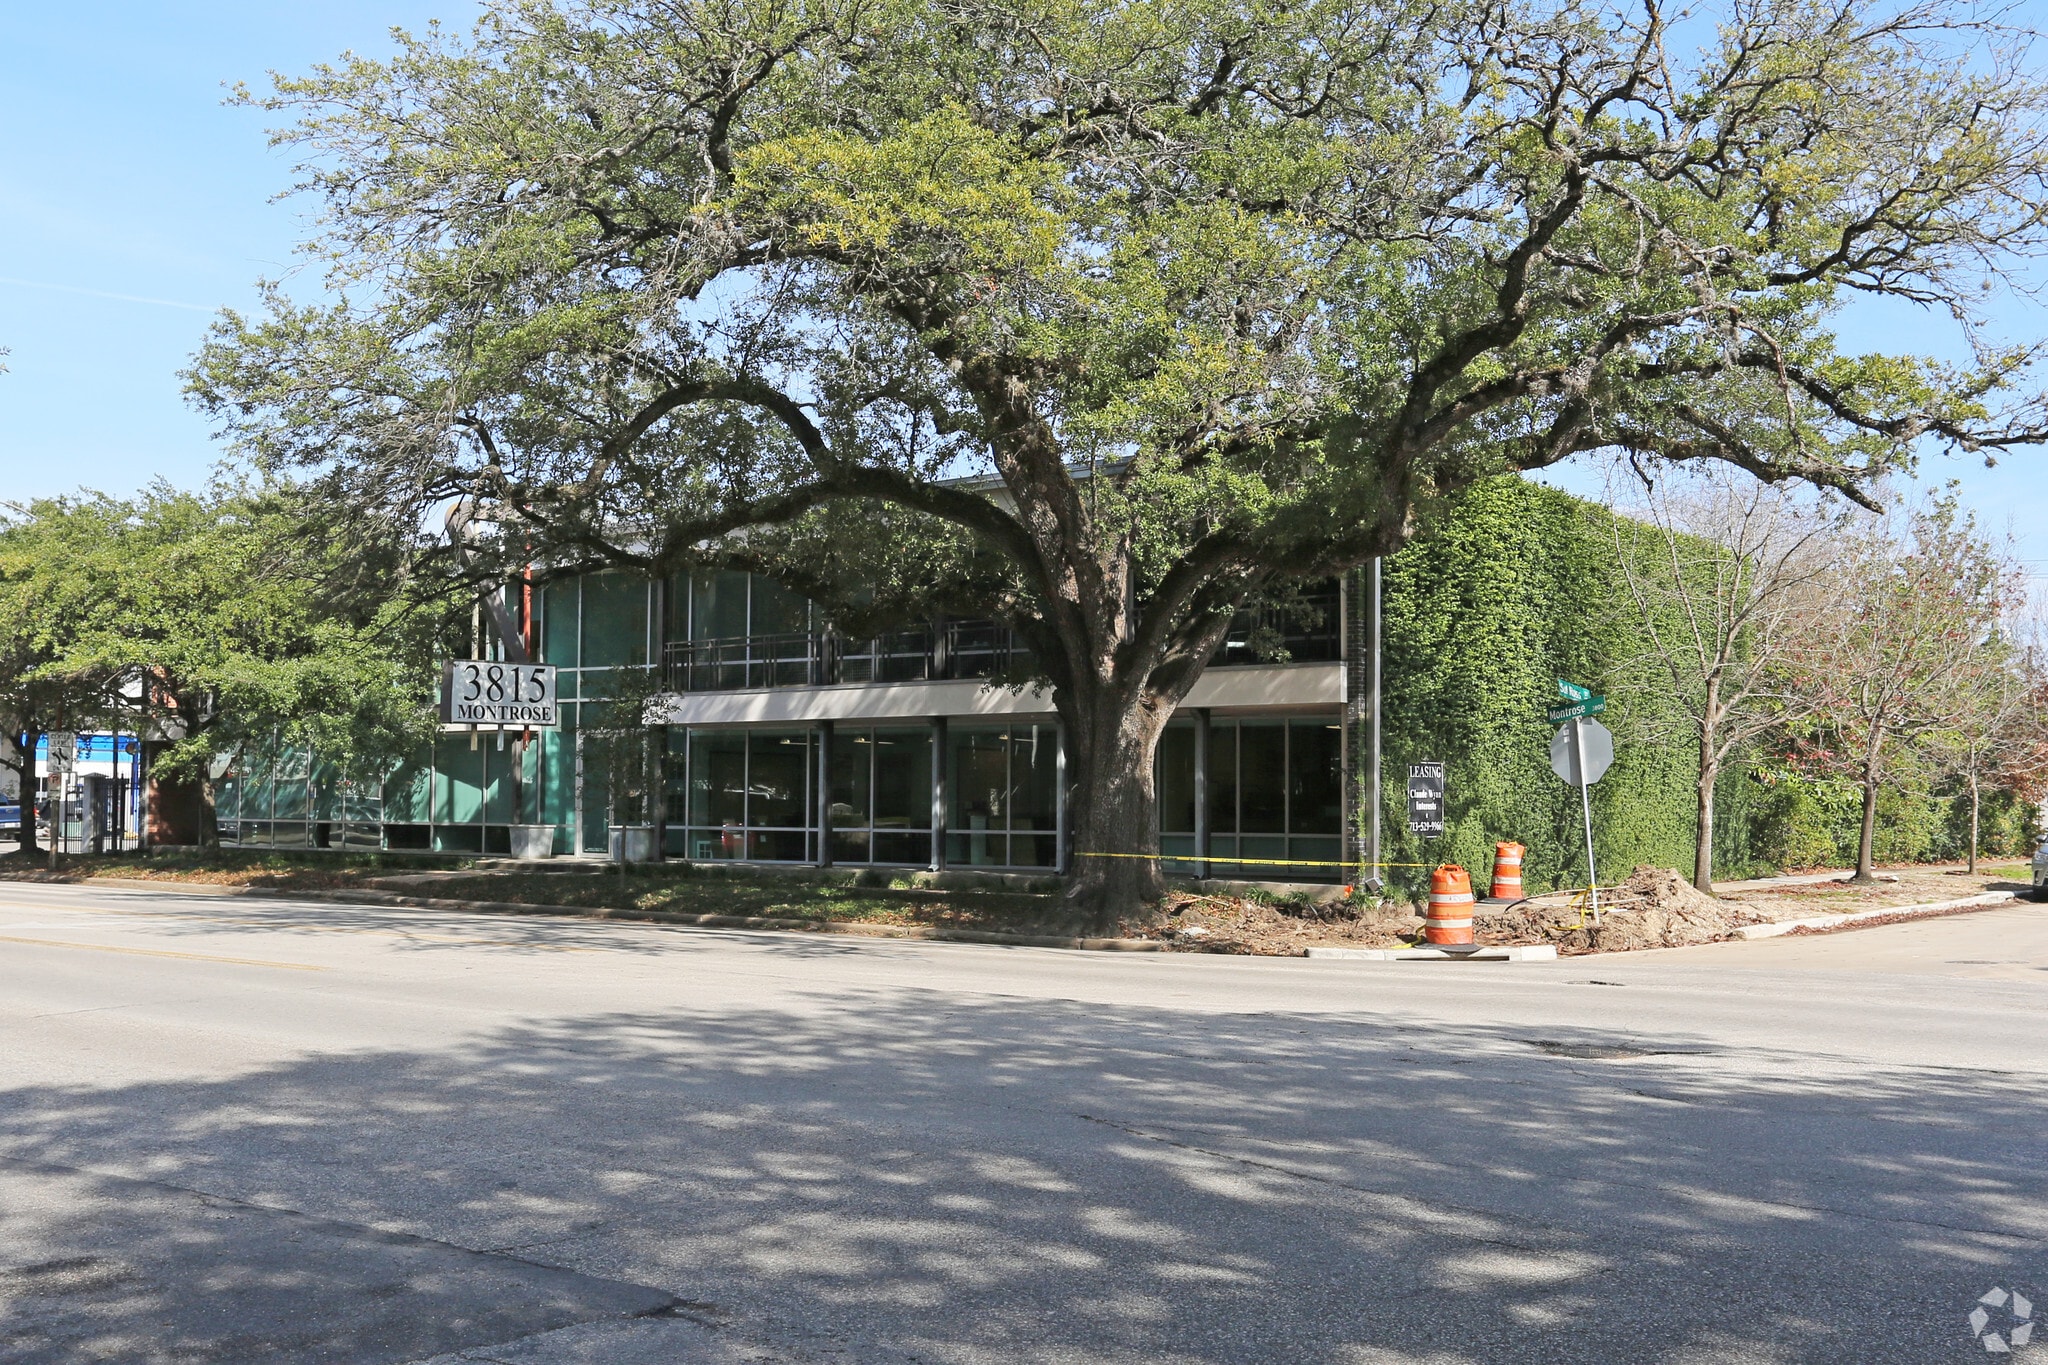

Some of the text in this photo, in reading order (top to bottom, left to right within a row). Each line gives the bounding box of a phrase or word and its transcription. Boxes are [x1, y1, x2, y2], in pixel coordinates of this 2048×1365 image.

[463, 664, 546, 704] 3815
[457, 704, 552, 721] MONTROSE
[1549, 704, 1586, 721] Montrose
[1409, 765, 1442, 778] LEASING
